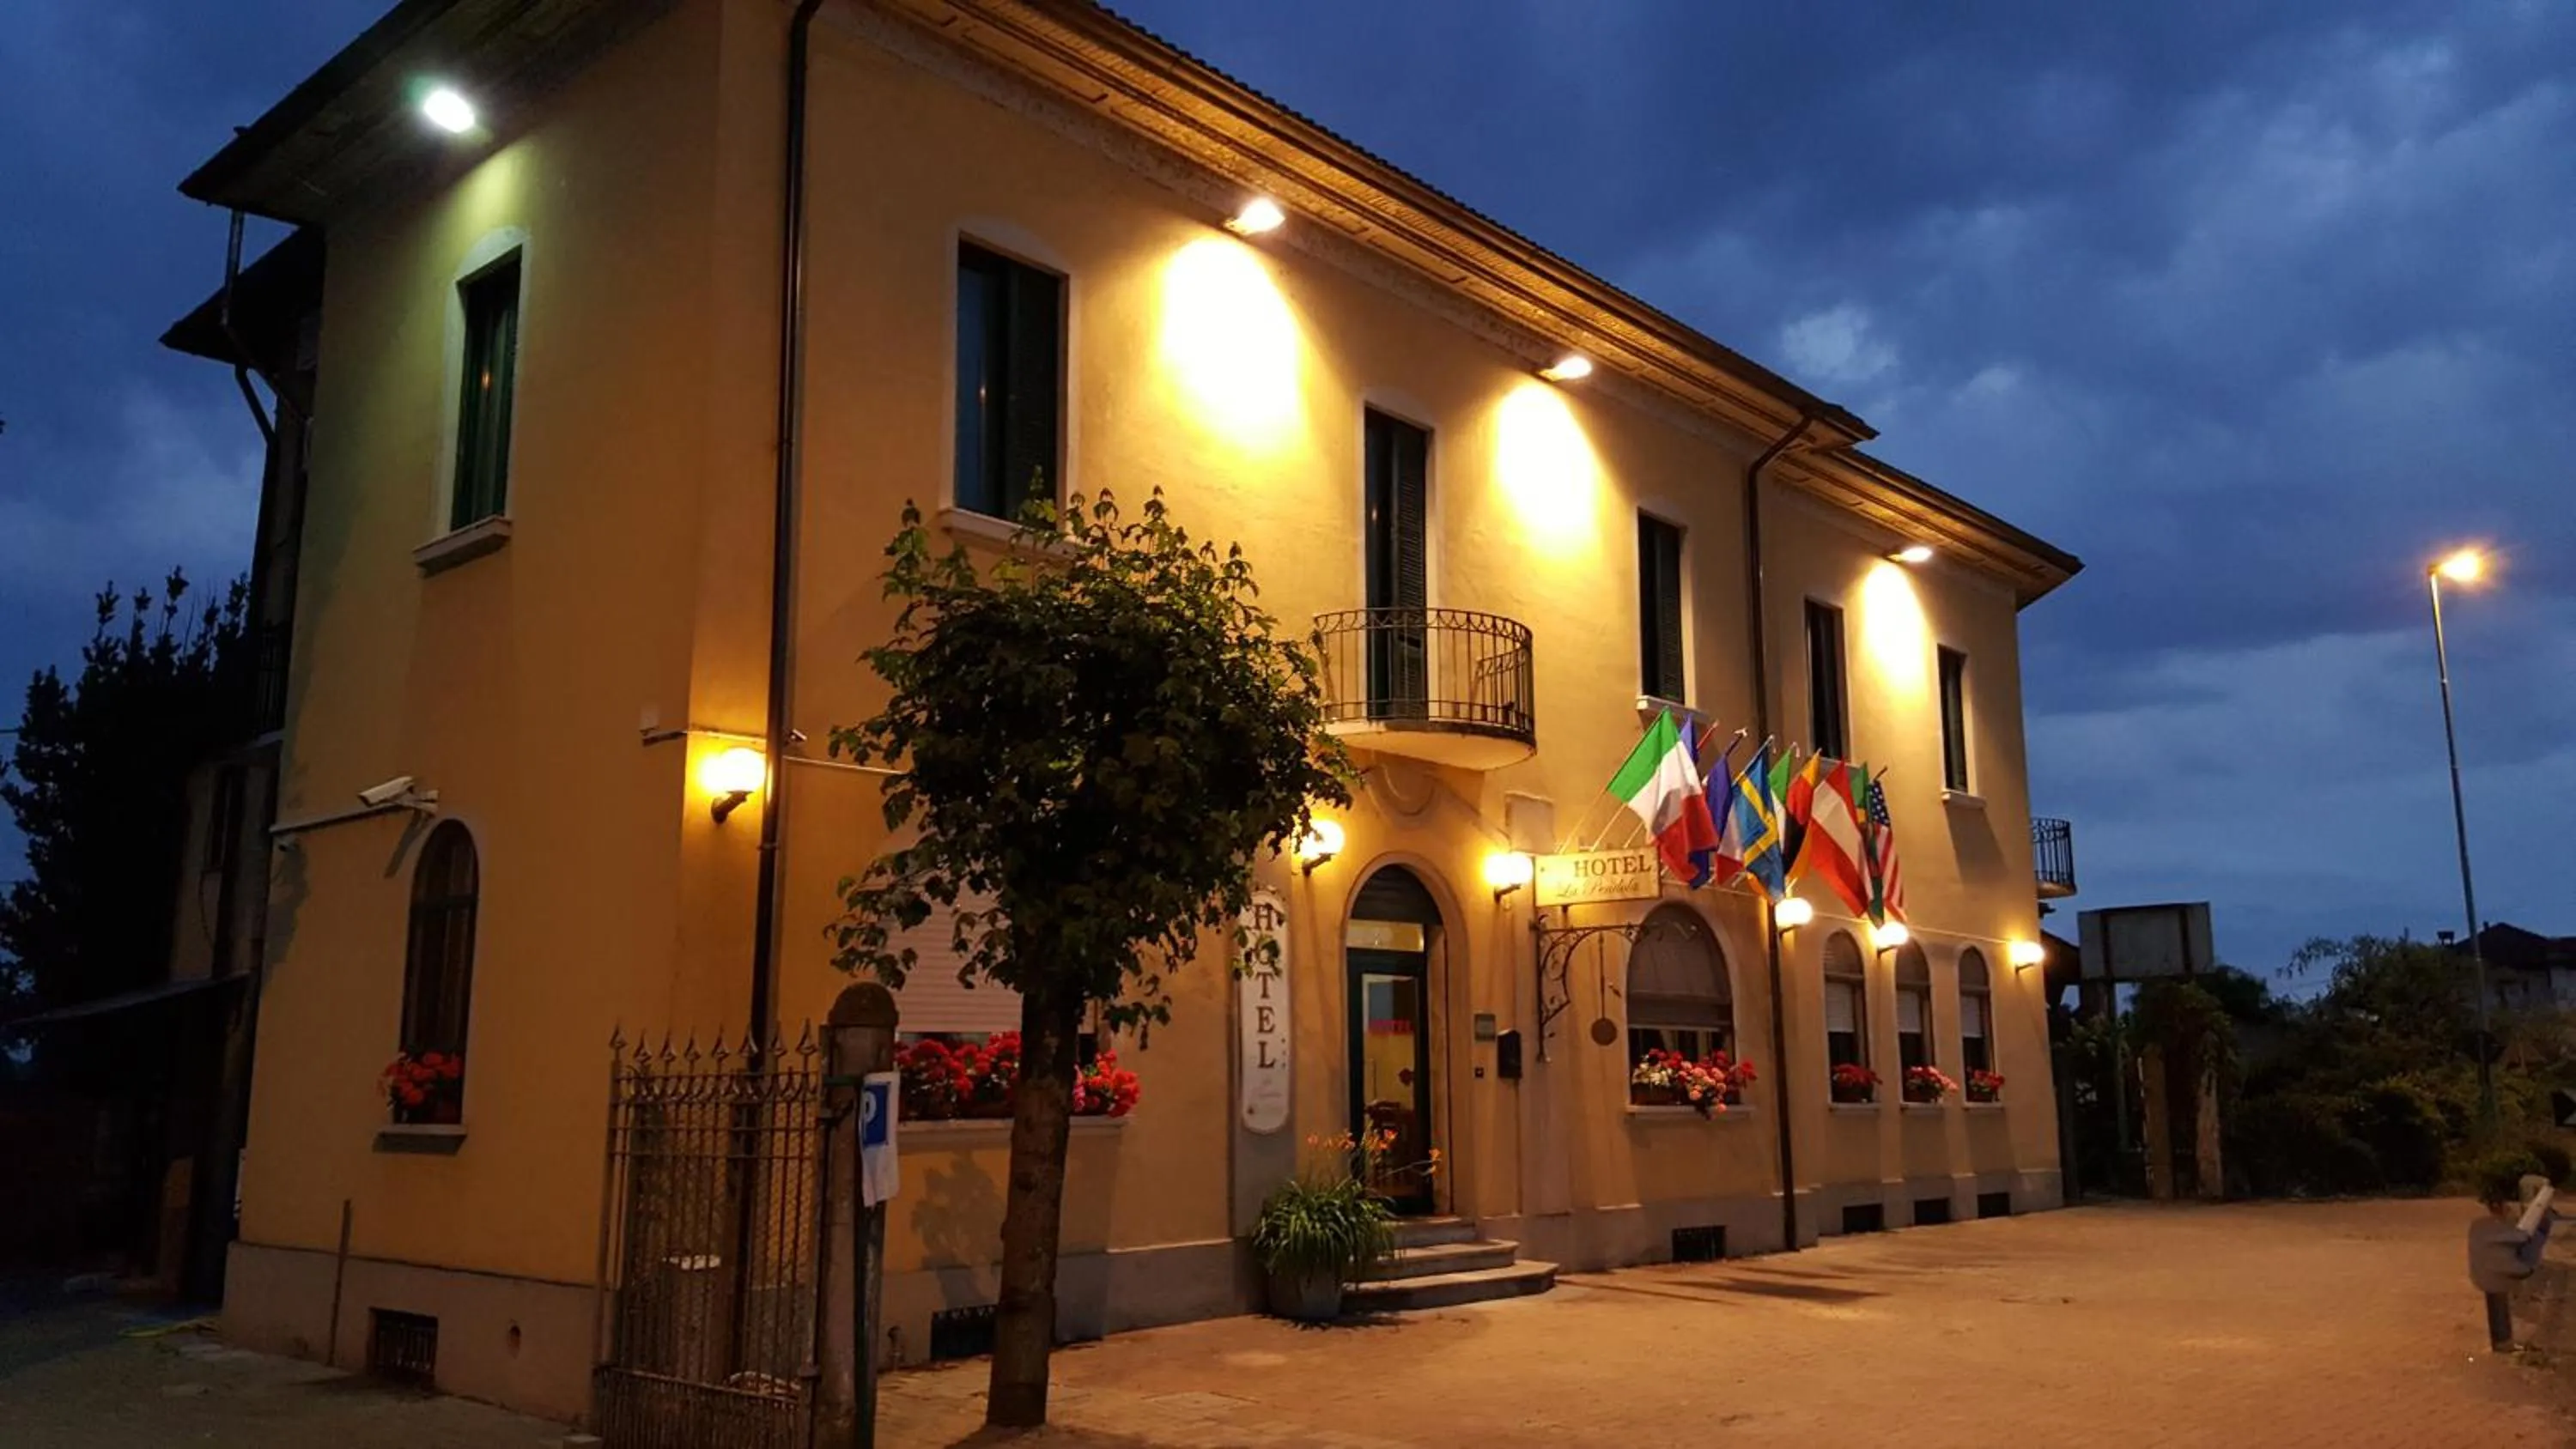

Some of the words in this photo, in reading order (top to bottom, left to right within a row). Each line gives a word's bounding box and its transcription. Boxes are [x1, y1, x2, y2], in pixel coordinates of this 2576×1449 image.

[1574, 854, 1651, 877] HOTEL
[1253, 904, 1276, 1069] HOTEL
[862, 1089, 877, 1143] P
